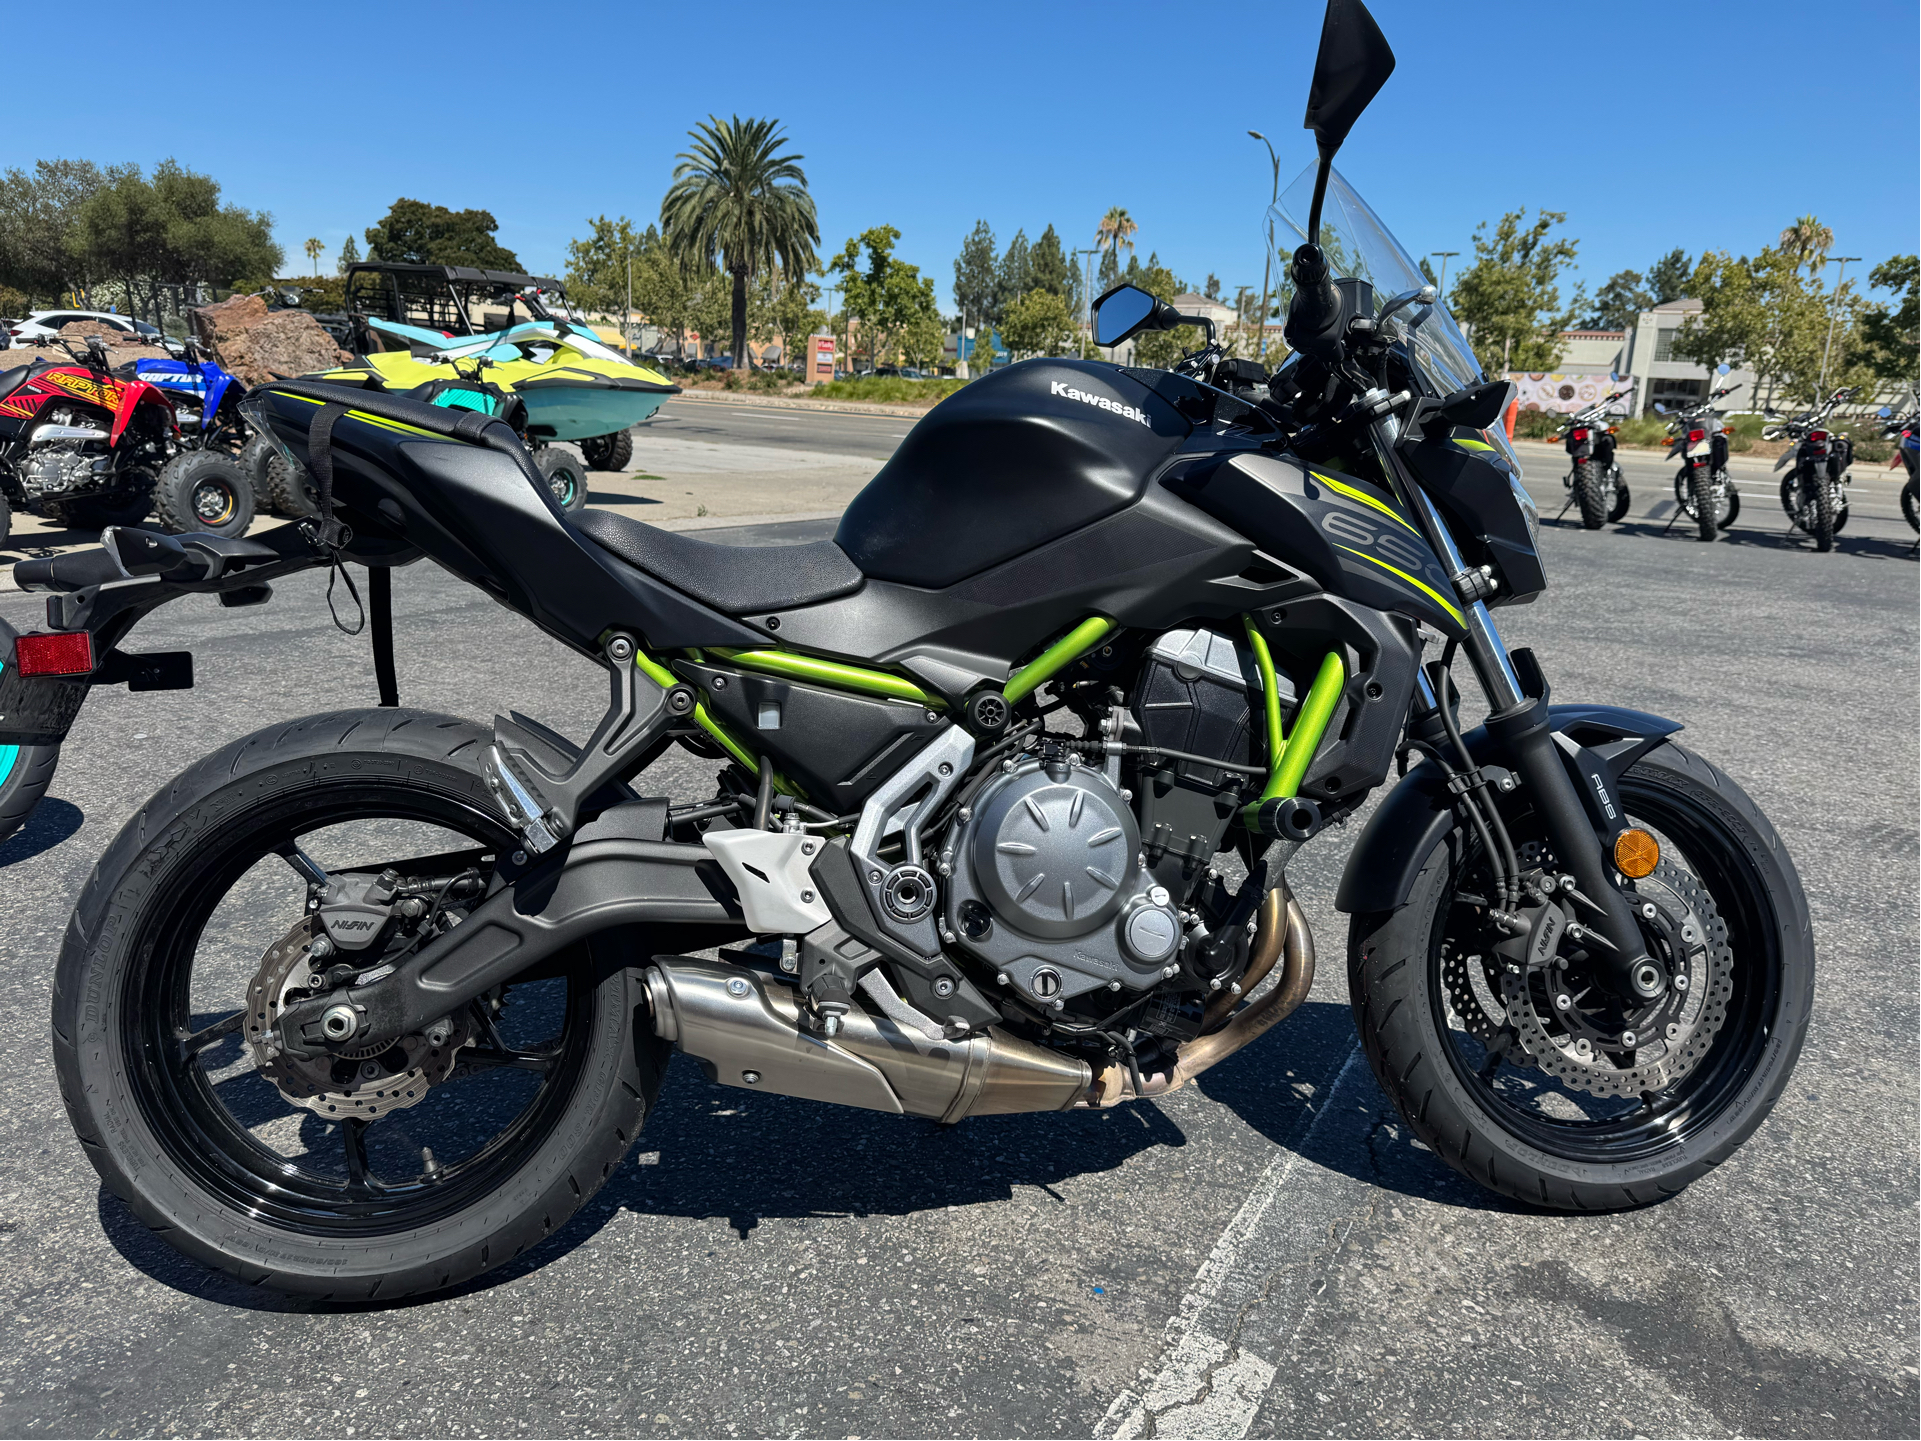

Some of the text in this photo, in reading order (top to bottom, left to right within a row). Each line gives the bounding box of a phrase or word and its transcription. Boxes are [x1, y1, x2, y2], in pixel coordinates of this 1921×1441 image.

[46, 371, 119, 404] RAPTOR
[1051, 381, 1152, 428] Kawasaki
[1590, 773, 1617, 820] ABS
[331, 919, 375, 931] NISSIN
[84, 914, 119, 1024] DUNLOP
[1074, 949, 1120, 972] Kawasaki
[103, 1112, 117, 1134] RADIAL
